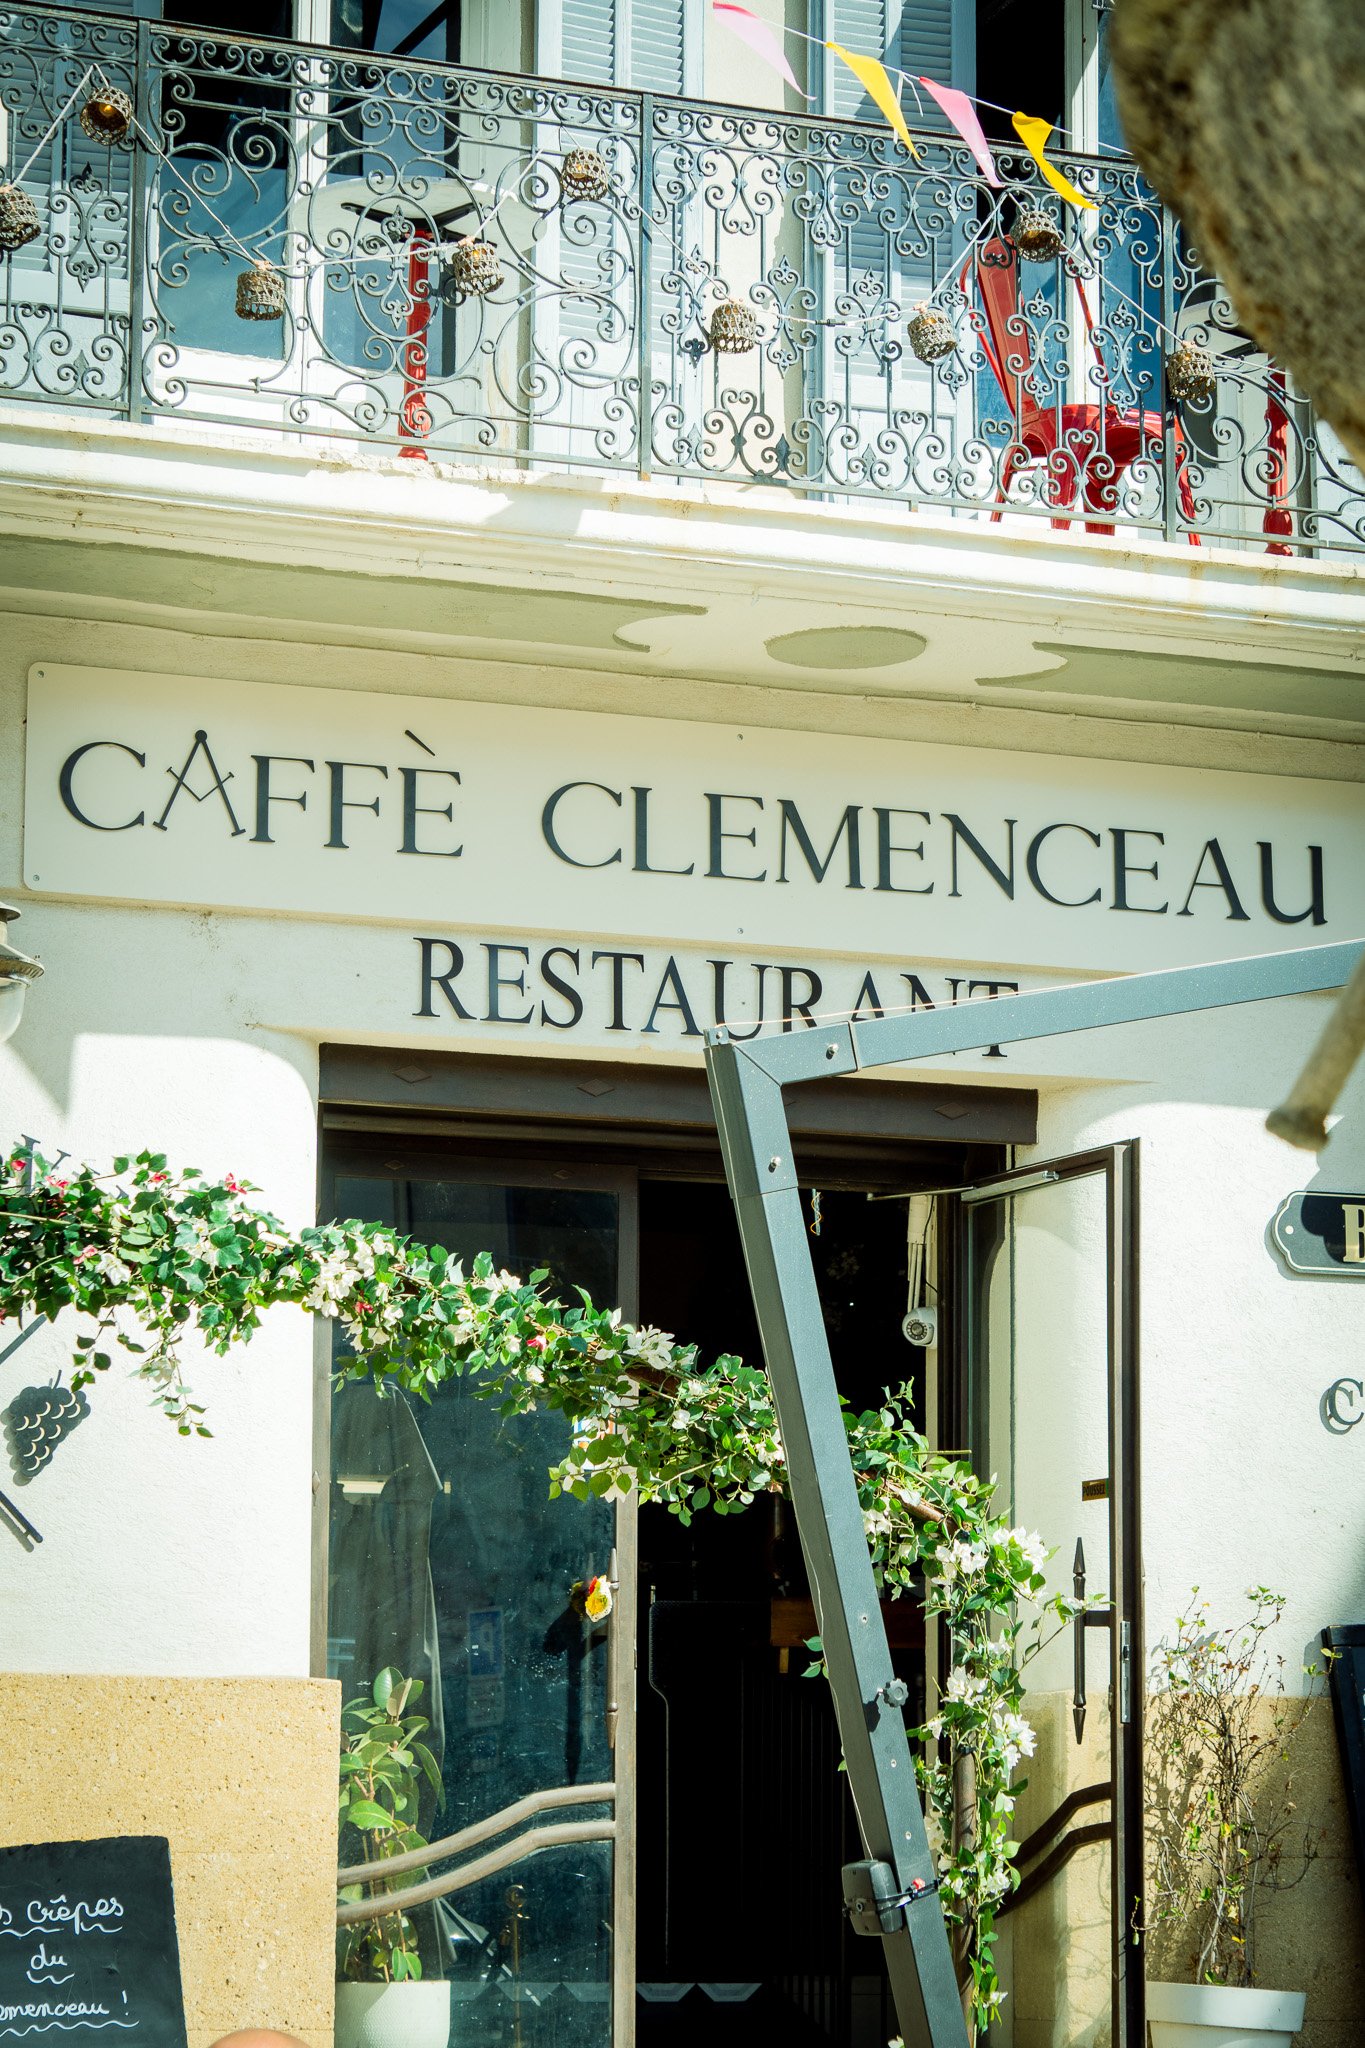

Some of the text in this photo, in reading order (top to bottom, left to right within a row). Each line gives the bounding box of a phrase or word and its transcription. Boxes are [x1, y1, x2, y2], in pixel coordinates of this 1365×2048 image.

[59, 729, 1329, 927] CAFFÈ CLEMENCEAU
[27, 1895, 124, 1936] Crêpes
[30, 1943, 68, 1970] du
